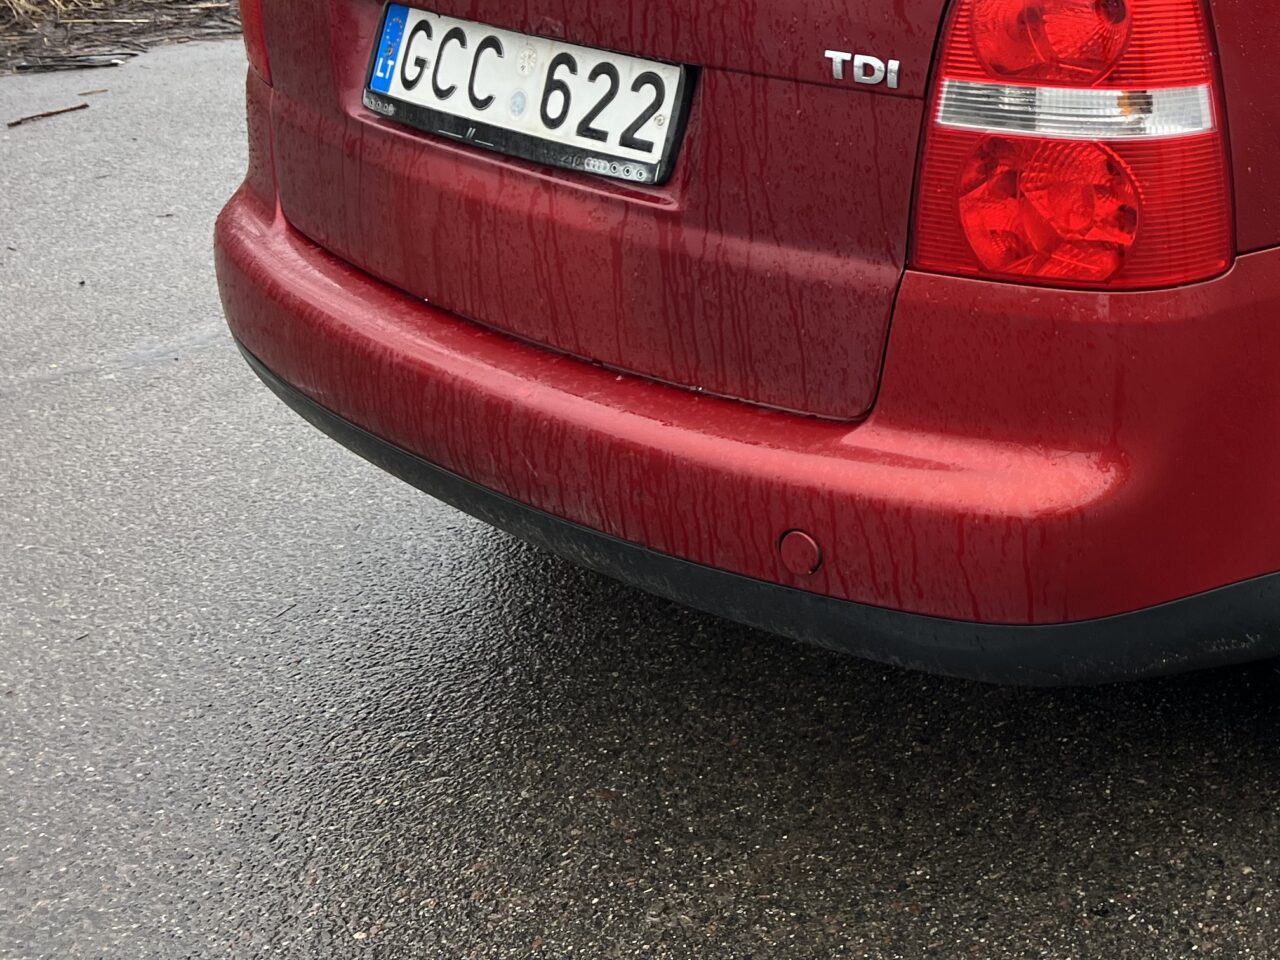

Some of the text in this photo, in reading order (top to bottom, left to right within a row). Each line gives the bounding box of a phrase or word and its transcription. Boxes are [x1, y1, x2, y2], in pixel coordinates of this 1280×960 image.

[375, 57, 395, 79] LT
[400, 19, 666, 154] GCC 622
[824, 49, 900, 89] TDI
